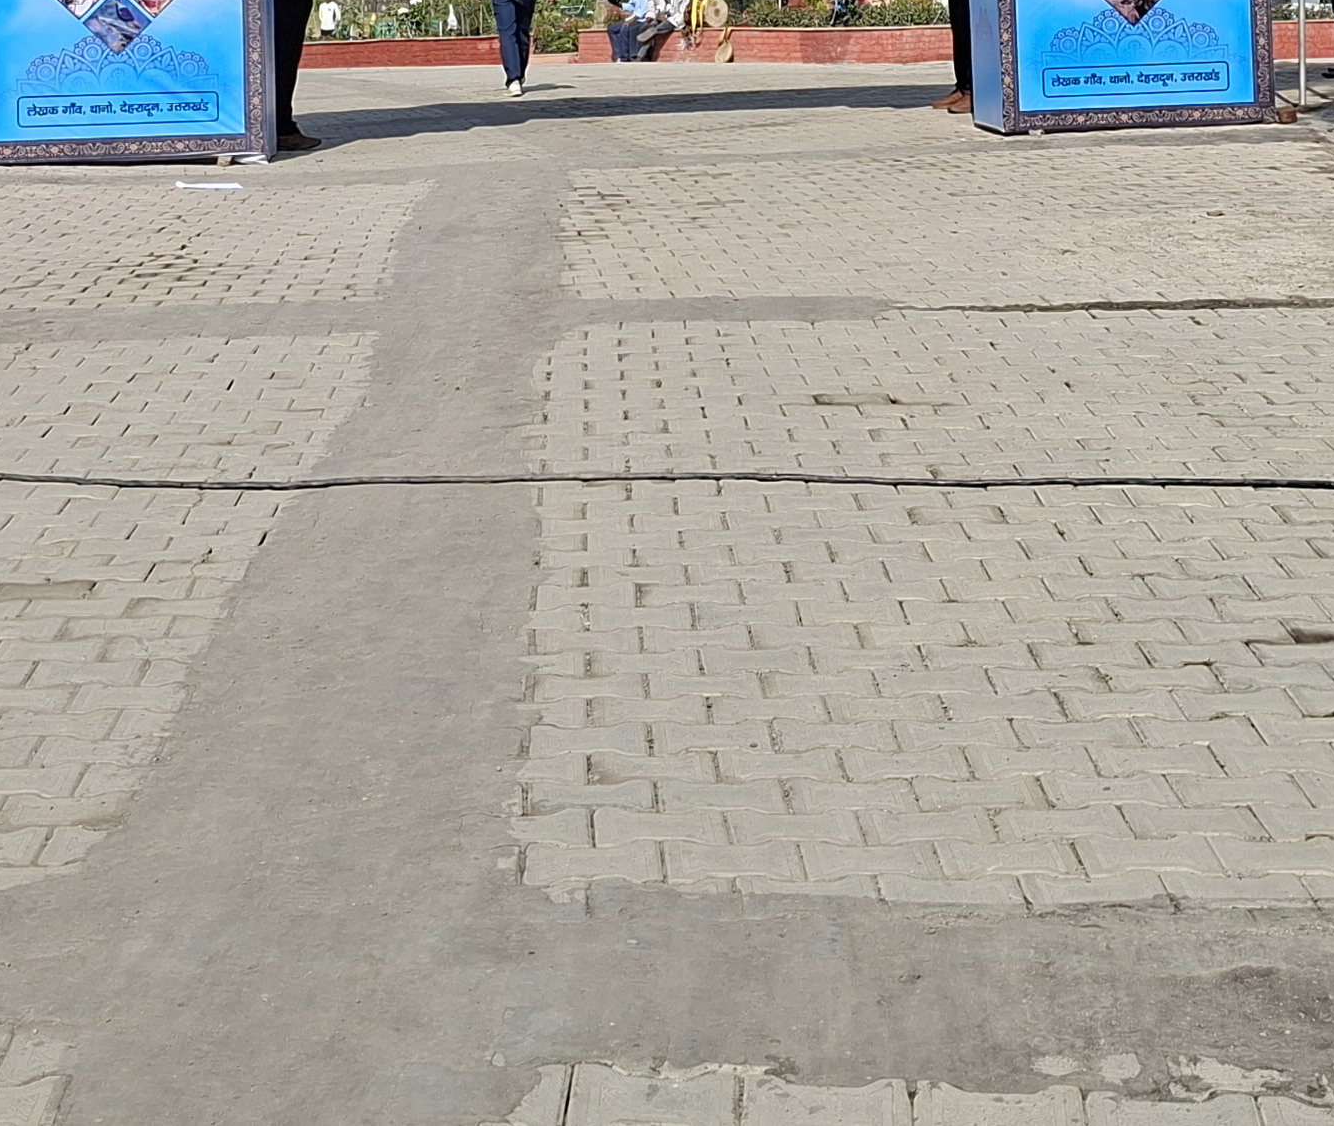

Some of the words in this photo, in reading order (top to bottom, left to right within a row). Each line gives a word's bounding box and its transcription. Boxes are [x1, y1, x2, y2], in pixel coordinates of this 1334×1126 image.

[1051, 74, 1081, 87] लेखक
[1137, 71, 1177, 87] देहरादून,
[1180, 68, 1221, 82] उत्तराखंड
[27, 104, 59, 116] लेखक
